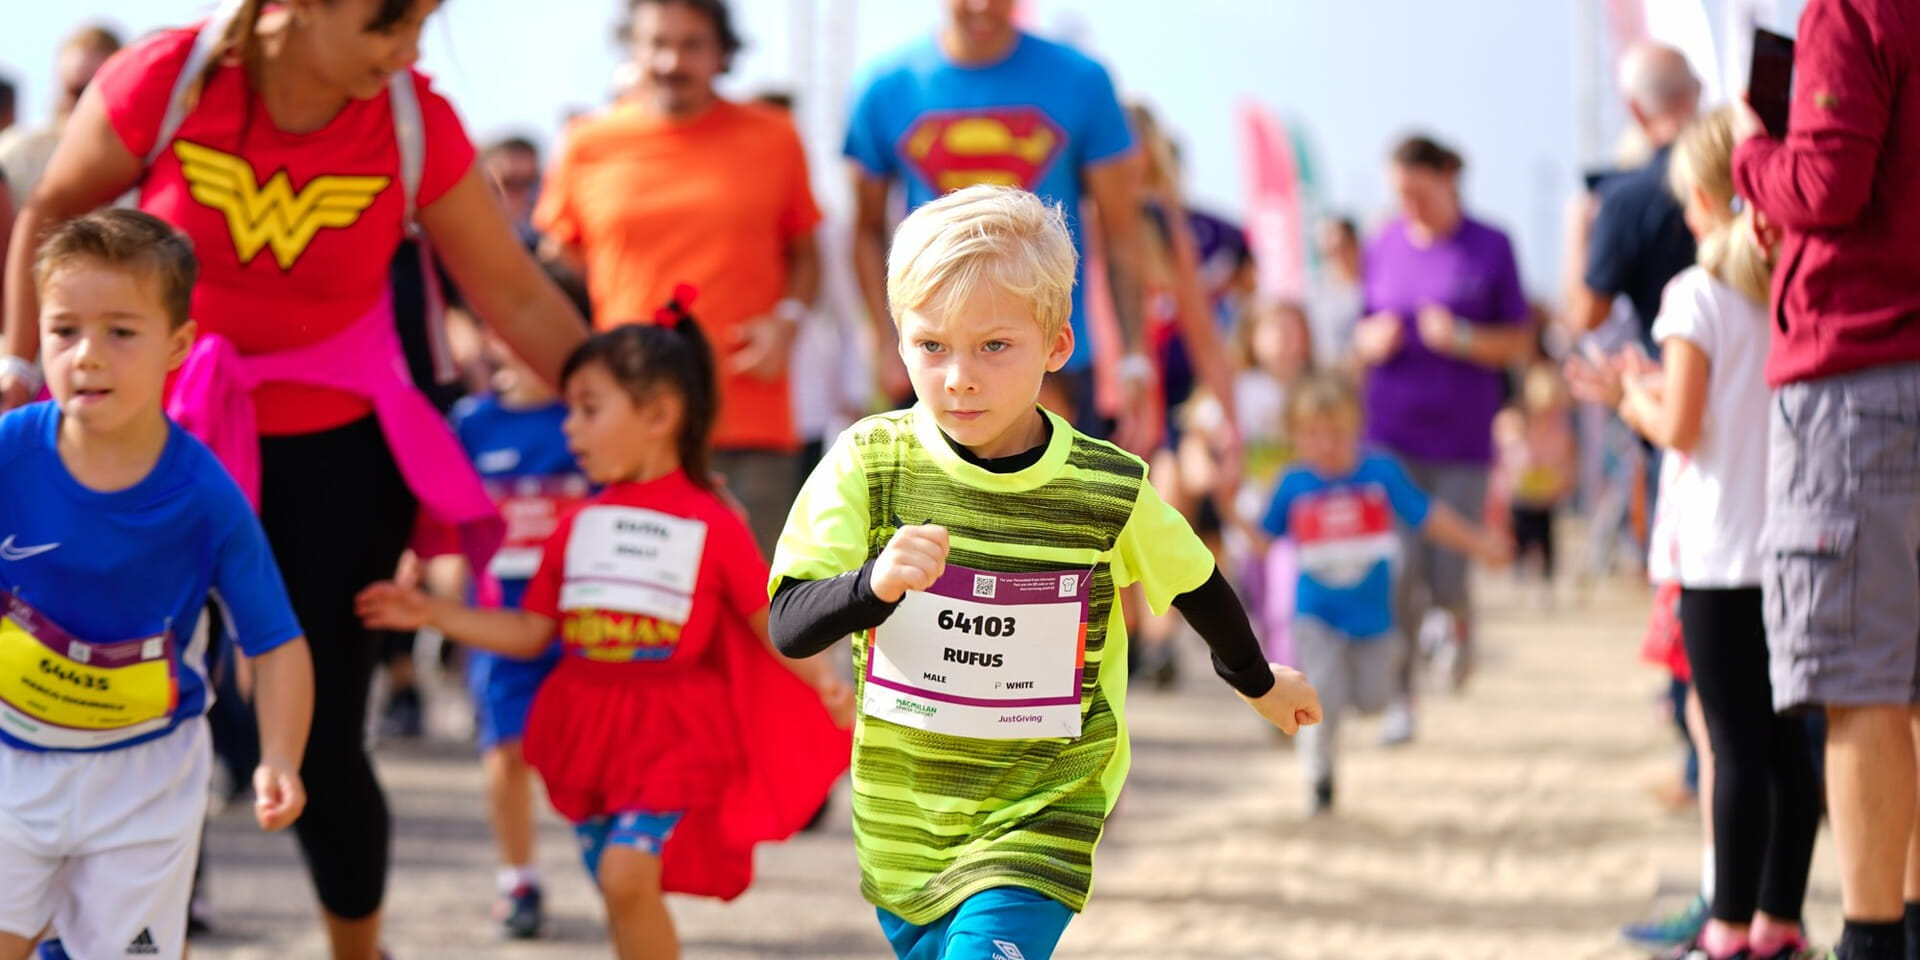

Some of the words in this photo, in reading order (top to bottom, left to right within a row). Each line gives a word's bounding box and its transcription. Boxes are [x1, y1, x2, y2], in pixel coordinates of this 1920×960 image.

[937, 609, 1016, 637] 64103
[943, 647, 1004, 668] RUFUS
[39, 659, 110, 691] 64435
[923, 671, 947, 684] MALE
[1006, 680, 1034, 690] WHITE
[895, 698, 938, 714] MACMILLAN
[998, 714, 1043, 724] JustGiving
